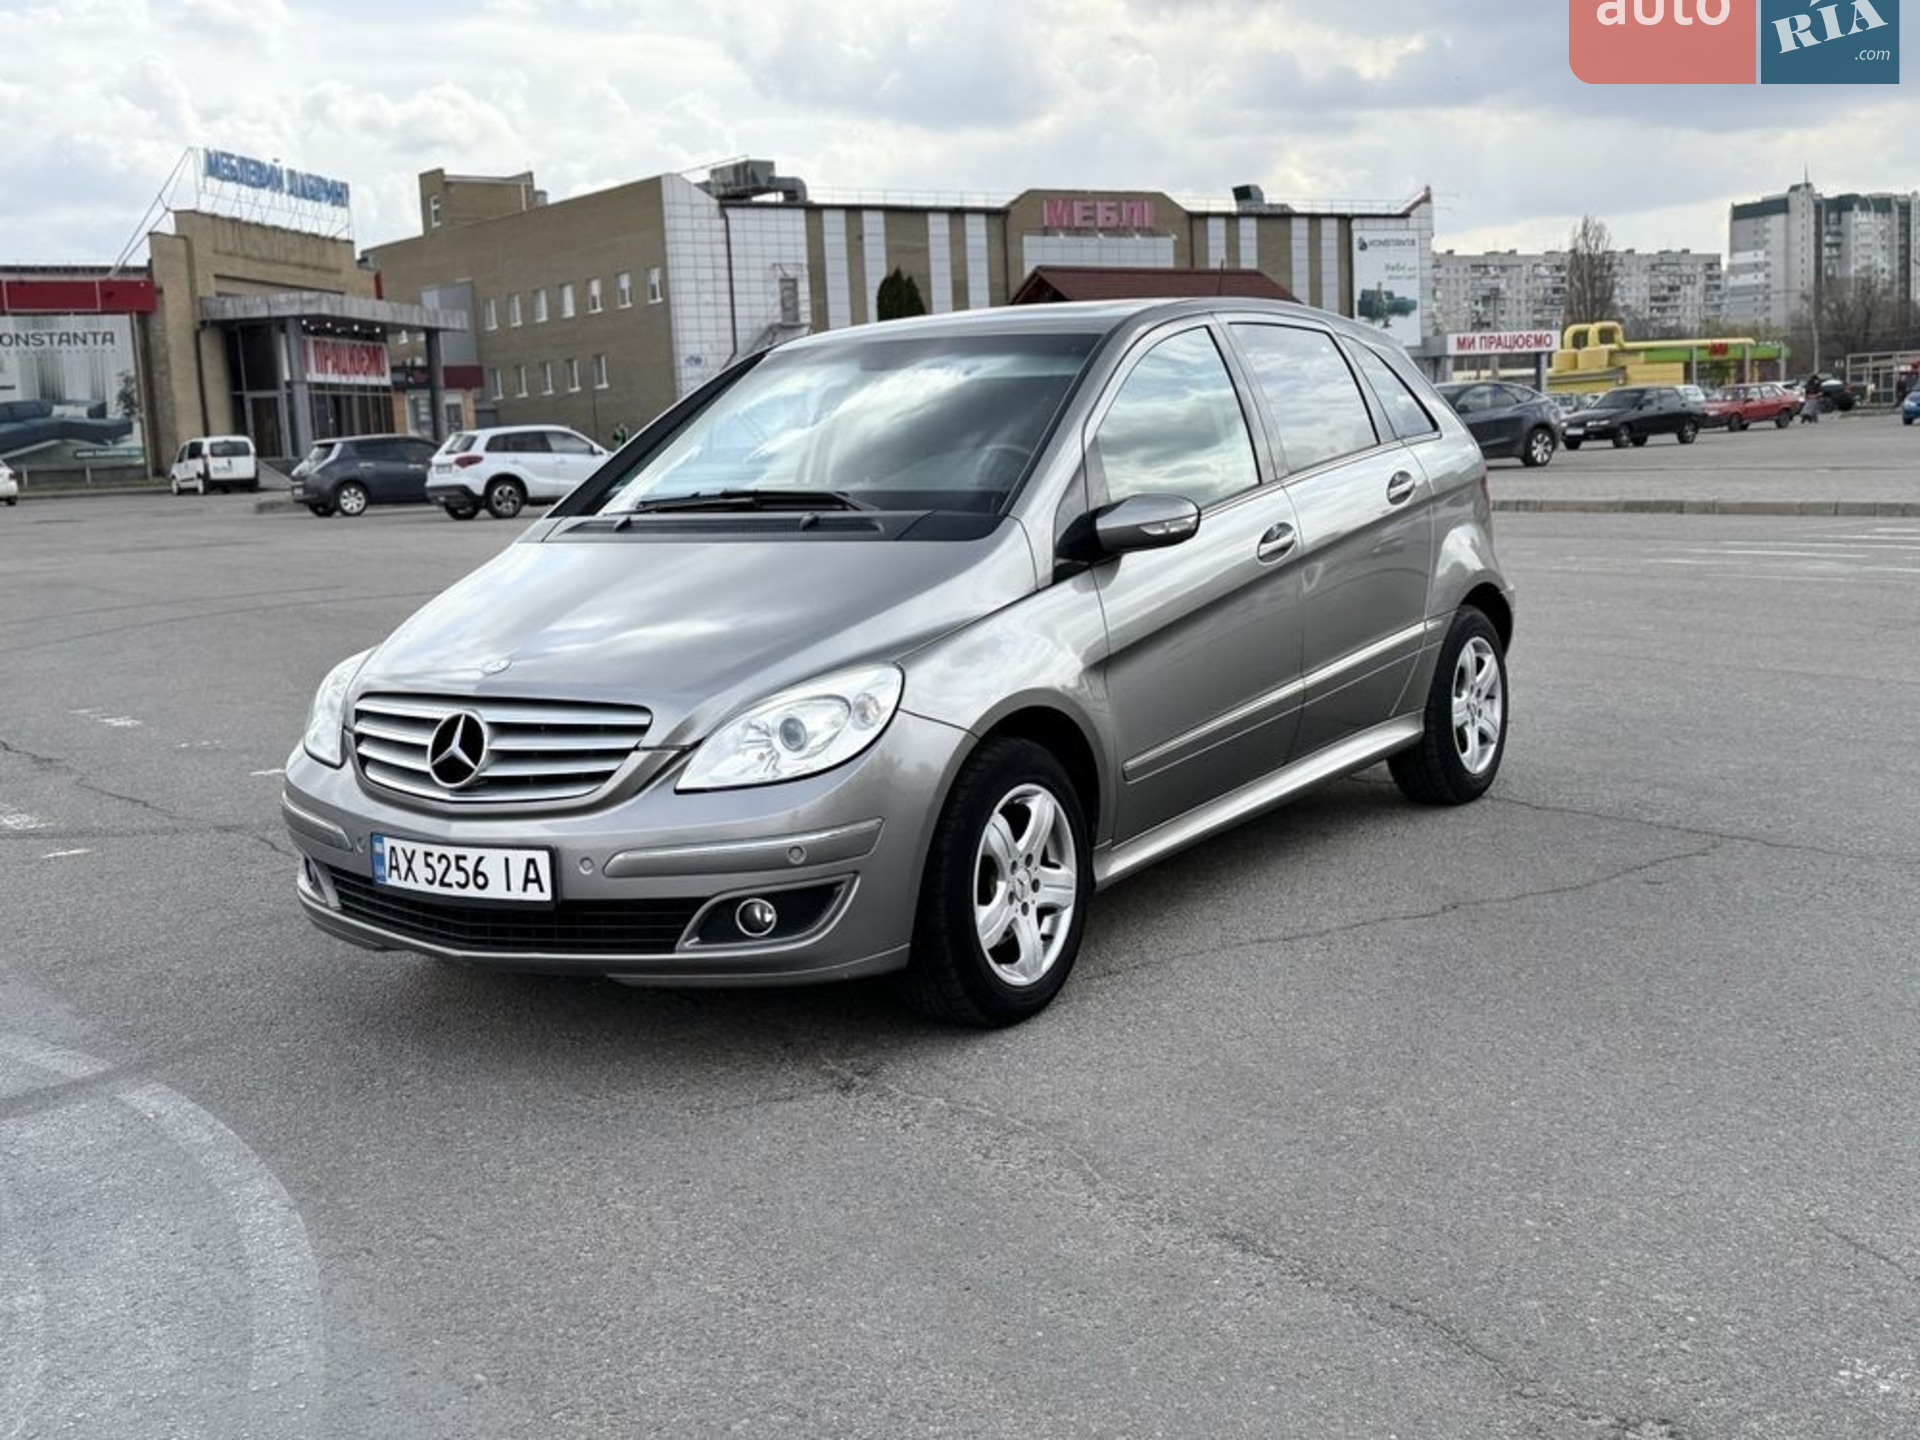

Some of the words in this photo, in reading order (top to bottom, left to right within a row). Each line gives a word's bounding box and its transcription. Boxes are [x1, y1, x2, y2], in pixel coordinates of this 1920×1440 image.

[1043, 199, 1155, 229] МЕБЛІ
[1456, 336, 1476, 351] МИ
[1480, 333, 1553, 352] ПРАЦЮЄМО
[424, 851, 489, 890] 5256
